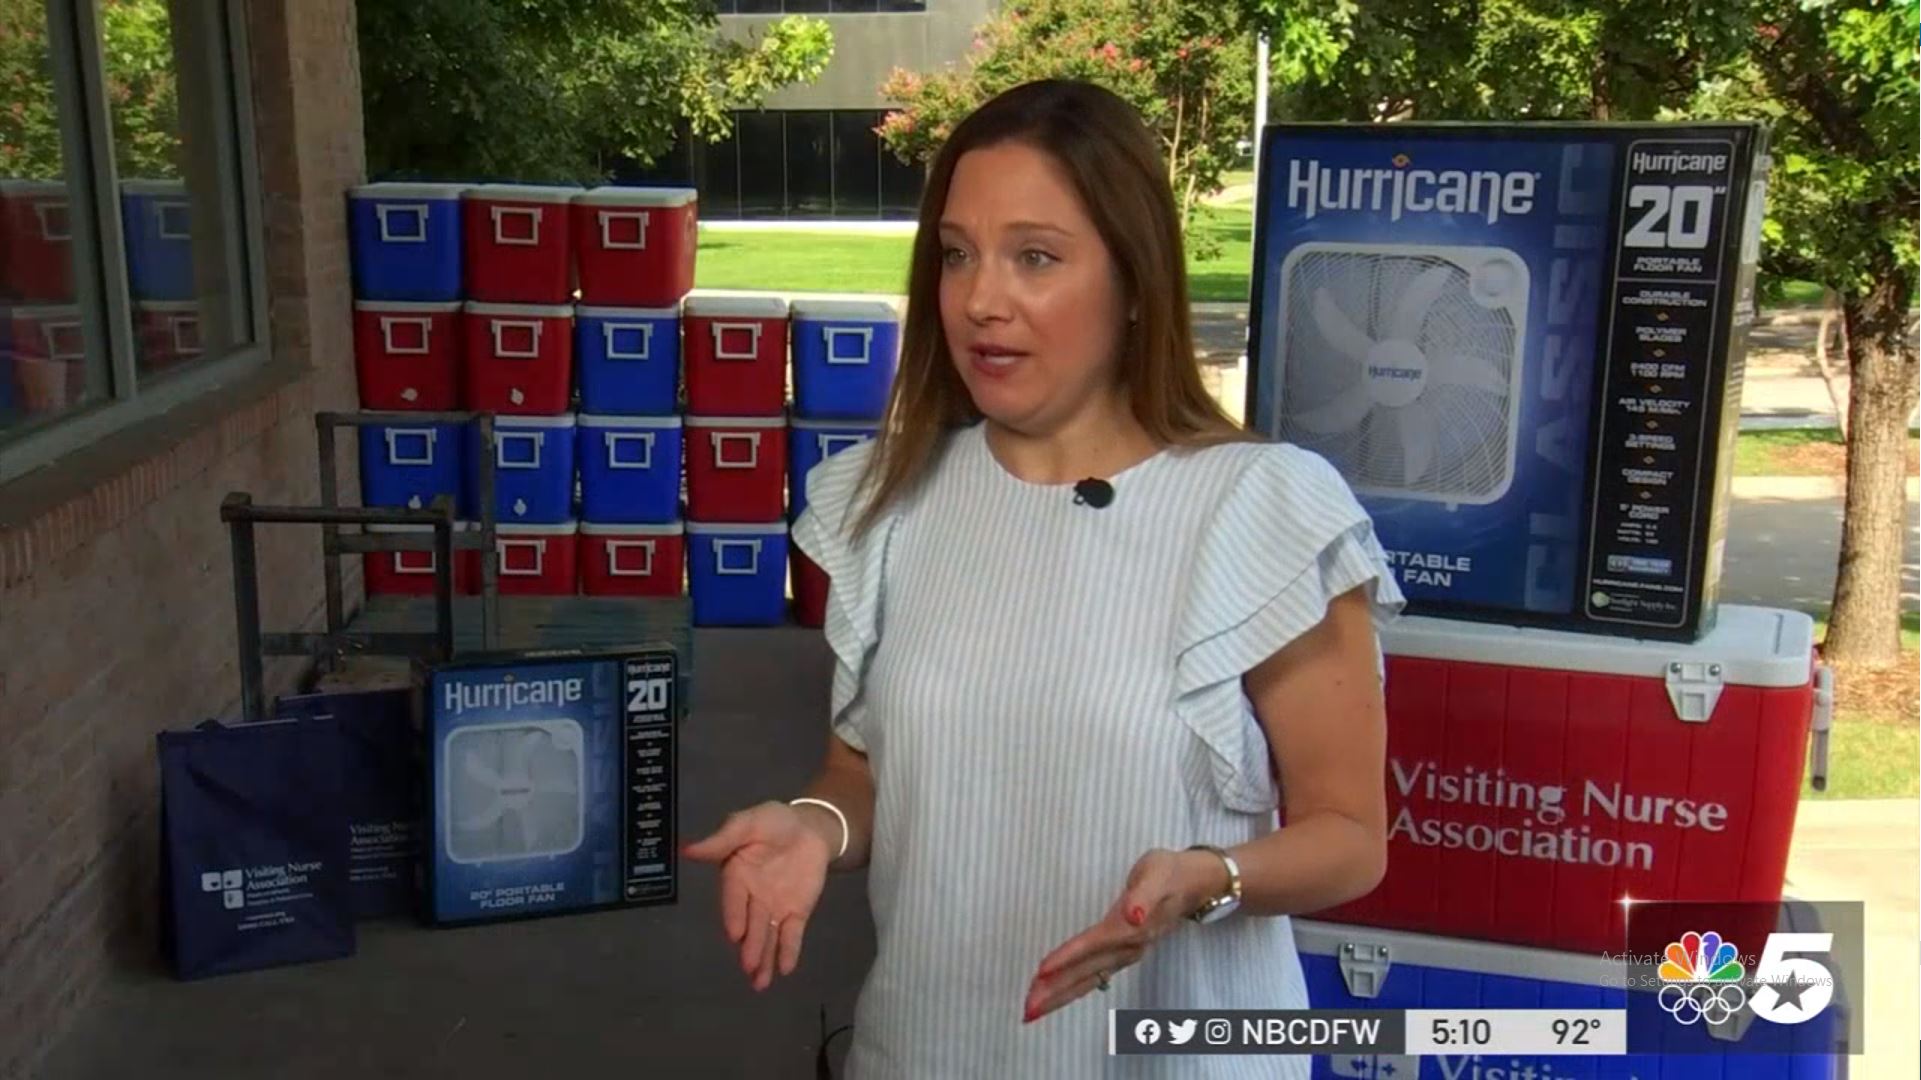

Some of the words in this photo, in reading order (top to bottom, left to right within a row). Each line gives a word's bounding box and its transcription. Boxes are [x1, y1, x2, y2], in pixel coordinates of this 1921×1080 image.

[1632, 151, 1728, 175] Hurricane
[1287, 158, 1534, 225] Hurricane
[1524, 143, 1615, 614] CLASSIC
[1384, 550, 1471, 572] RTABLE
[1403, 569, 1452, 587] FAN
[445, 677, 582, 714] Hurricane
[1390, 758, 1568, 826] Visiting
[1583, 780, 1728, 831] Nurse
[1388, 806, 1653, 871] Association
[245, 863, 286, 880] Visiting
[287, 861, 323, 872] Nurse
[246, 874, 308, 891] Association
[495, 882, 565, 896] PORTABLE
[480, 896, 525, 909] FLOOR
[528, 893, 556, 905] FAN
